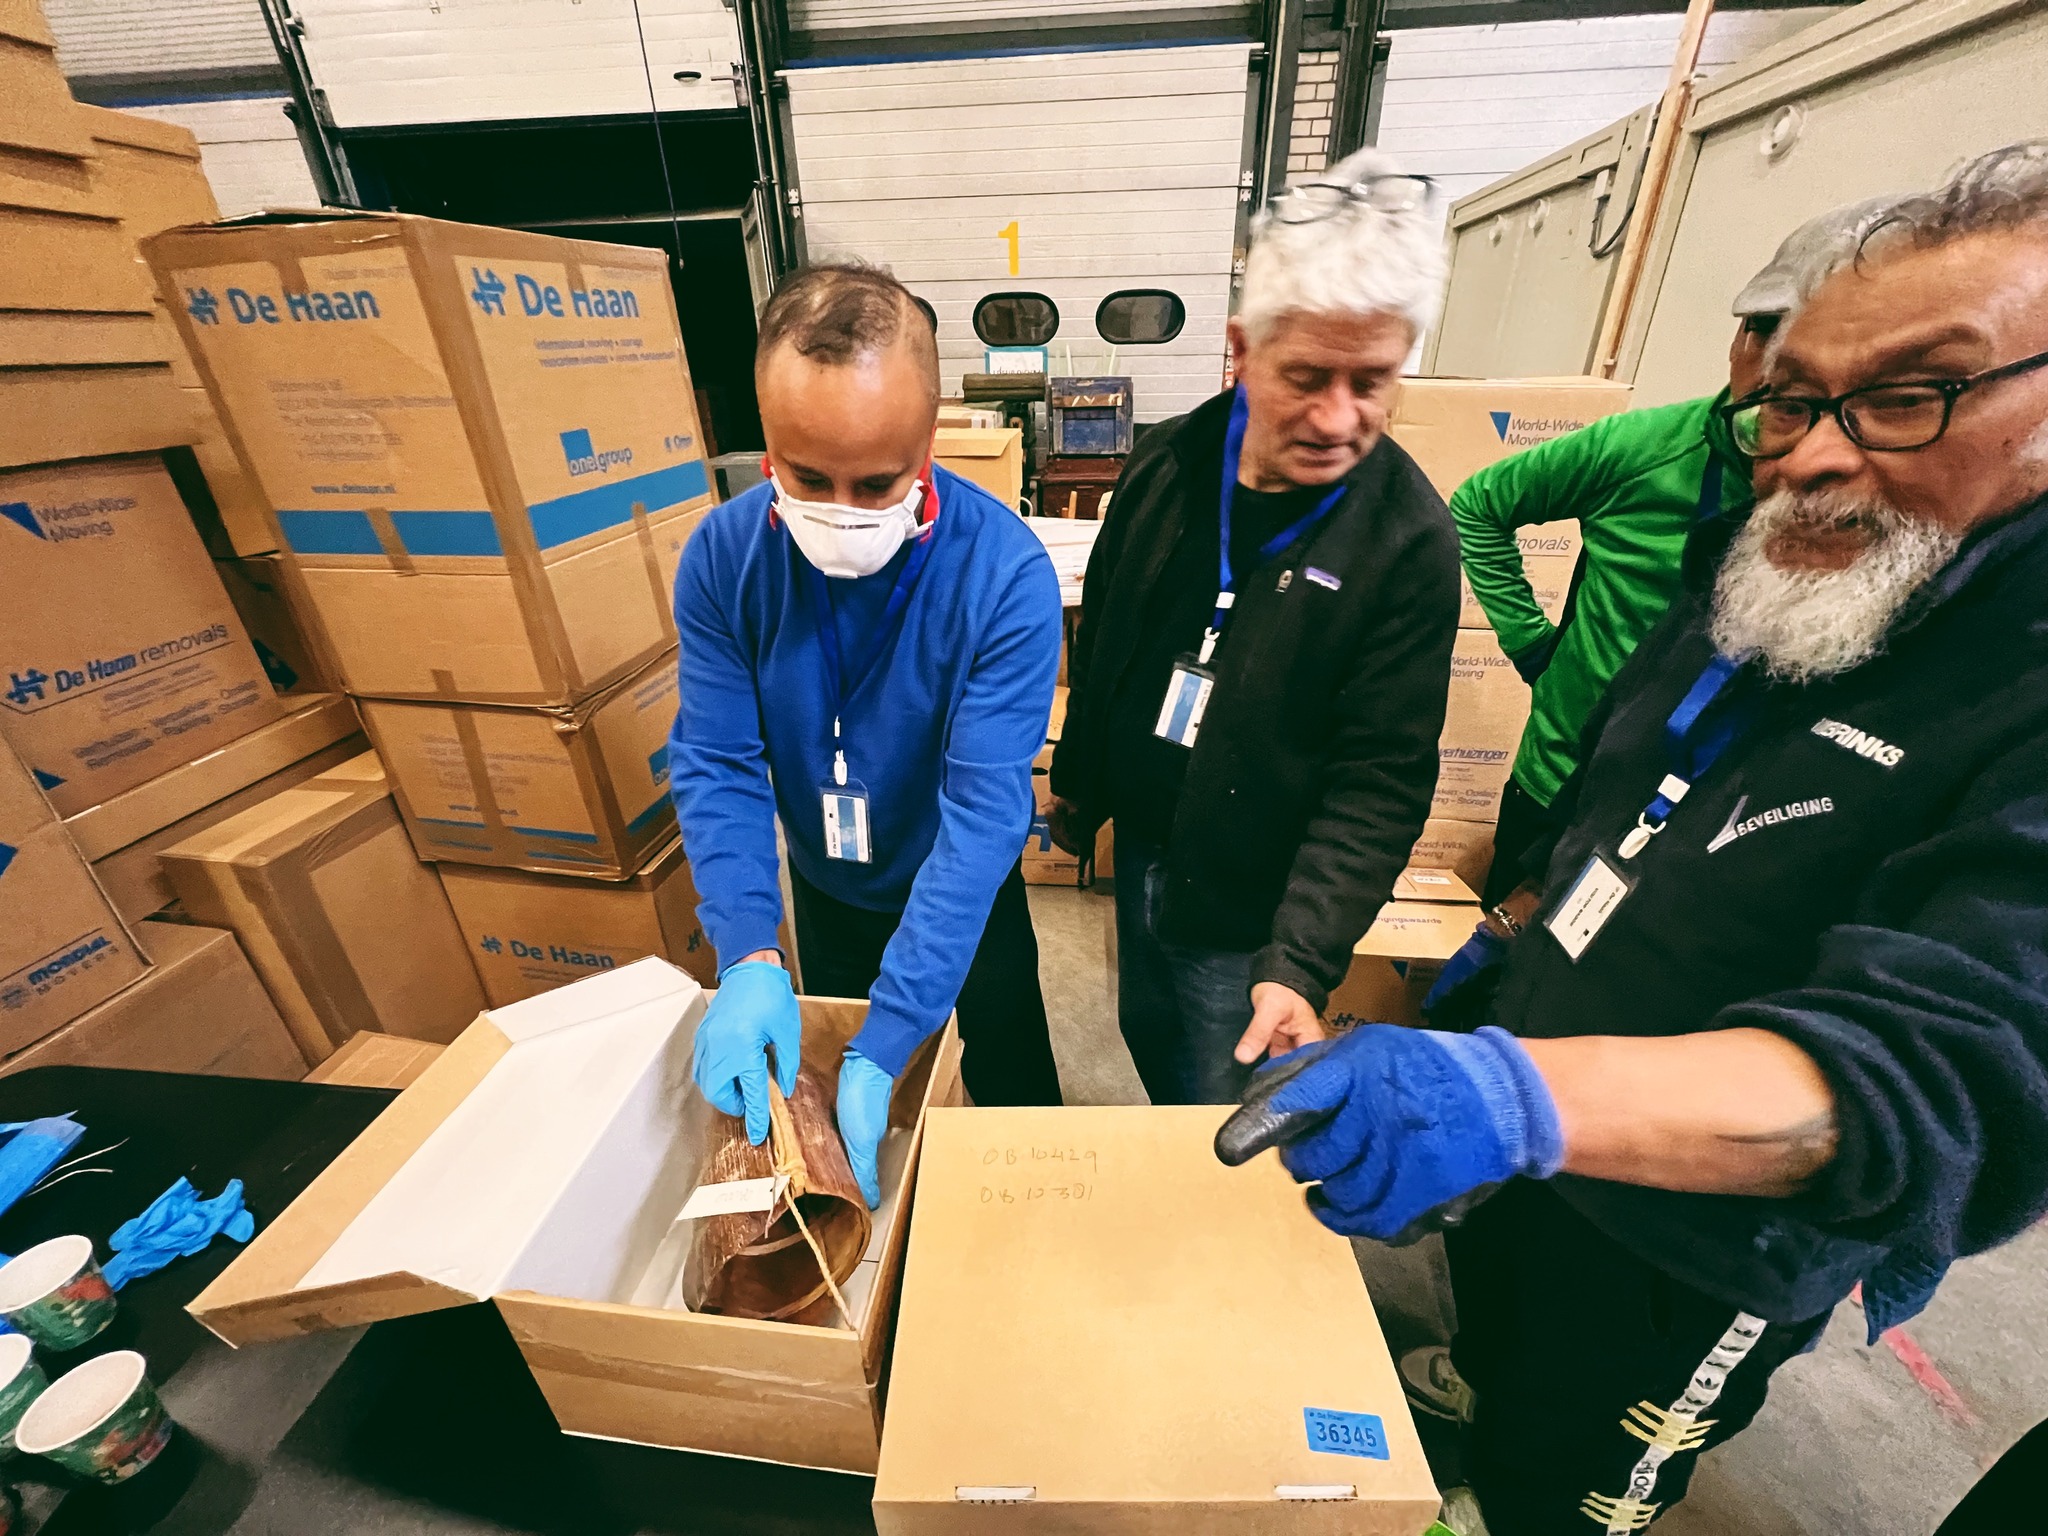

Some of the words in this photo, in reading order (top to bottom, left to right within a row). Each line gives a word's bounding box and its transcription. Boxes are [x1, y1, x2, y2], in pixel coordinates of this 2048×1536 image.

[998, 221, 1019, 277] 1
[226, 288, 280, 323] De
[283, 289, 380, 322] Haan
[515, 274, 565, 317] De
[570, 288, 640, 318] Haan
[1508, 434, 1554, 446] Movin
[1512, 419, 1585, 431] World-Wide
[54, 669, 86, 693] De
[140, 623, 229, 664] removals
[1736, 796, 1834, 837] BEVEILIGING
[509, 939, 545, 961] De
[548, 944, 615, 968] Haan
[1314, 1421, 1378, 1448] 36345
